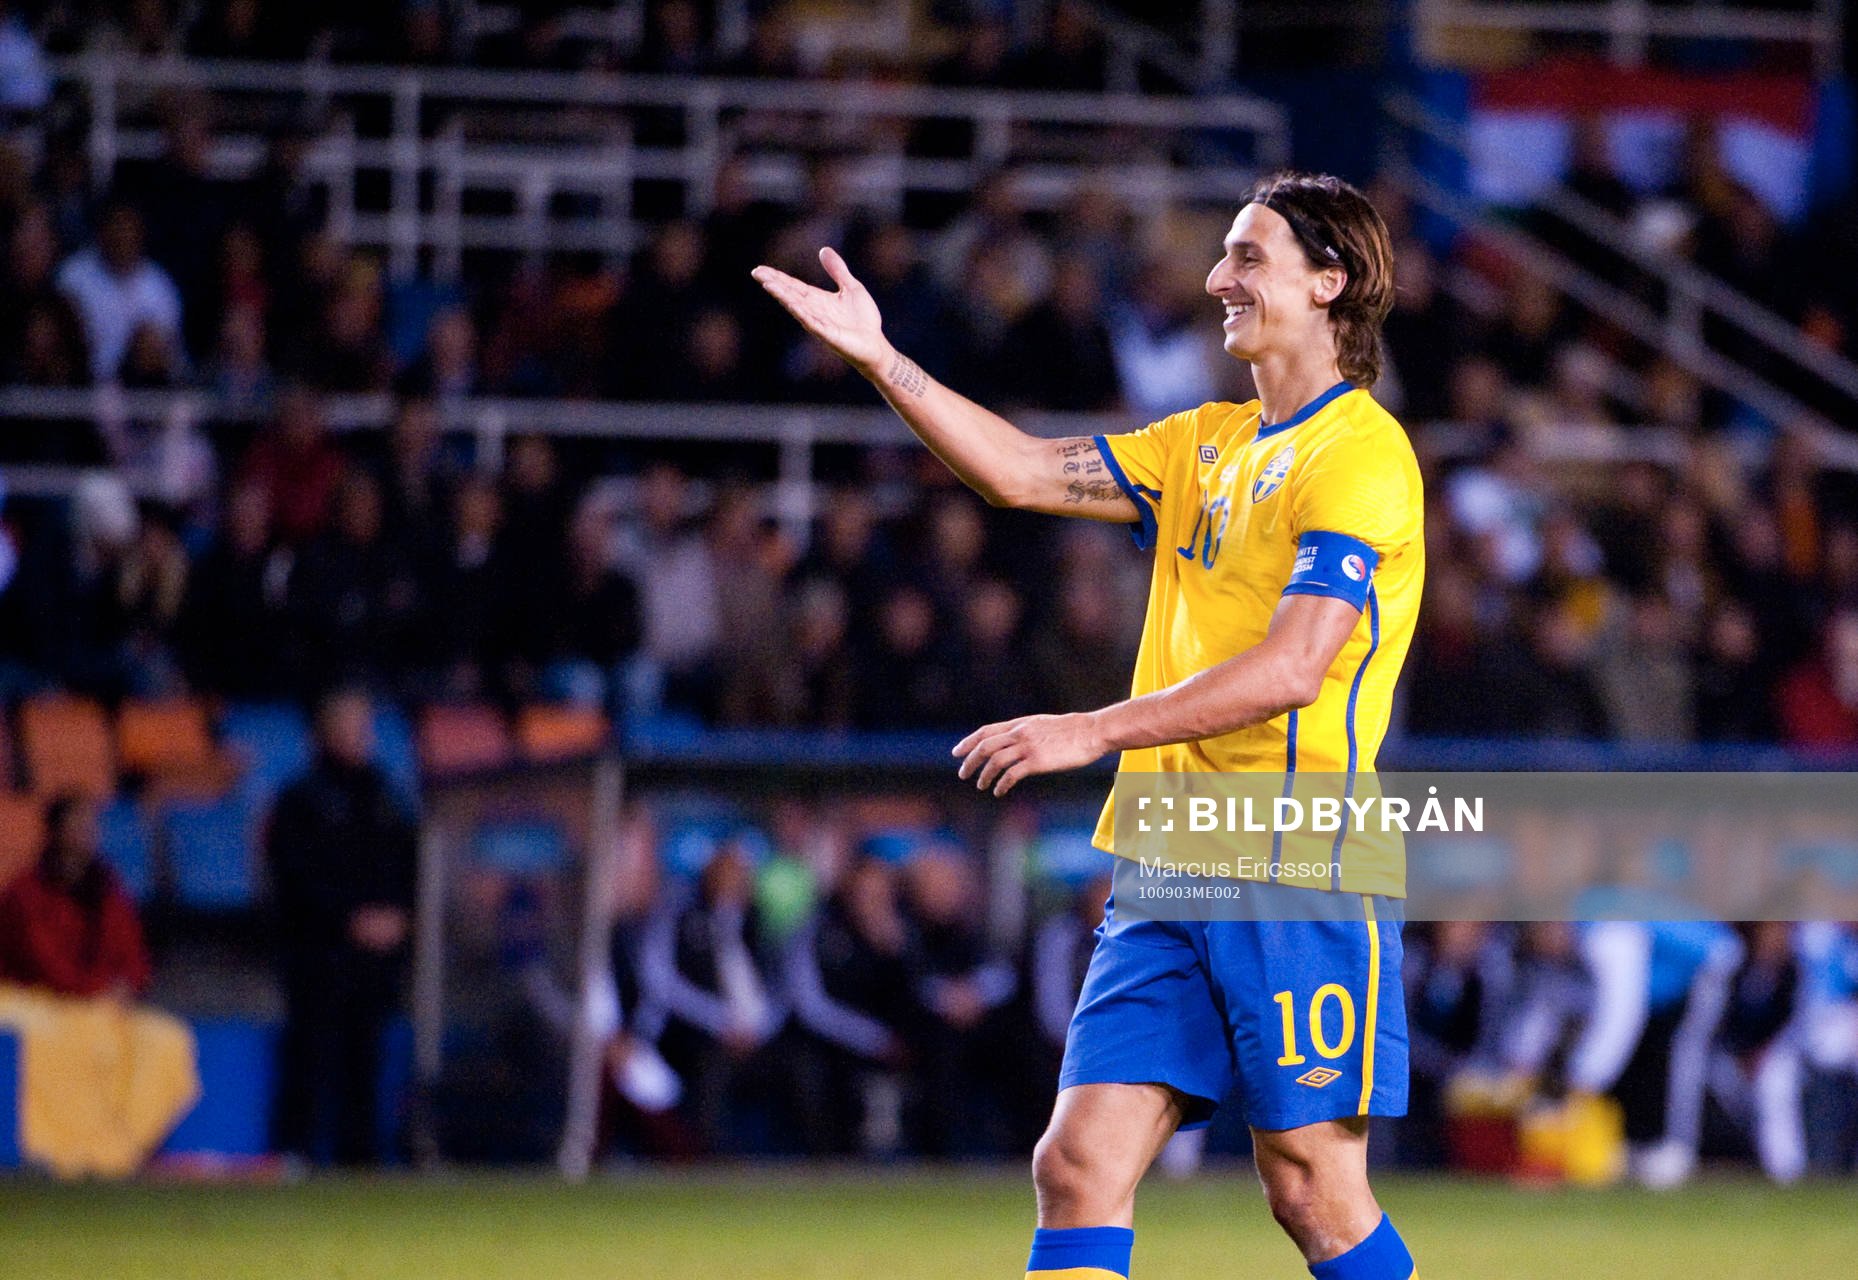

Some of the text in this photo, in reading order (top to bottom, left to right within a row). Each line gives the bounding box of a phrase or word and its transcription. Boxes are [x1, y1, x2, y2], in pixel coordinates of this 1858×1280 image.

[1177, 490, 1230, 570] 10
[1298, 546, 1319, 556] NITE
[1273, 983, 1356, 1066] 10
